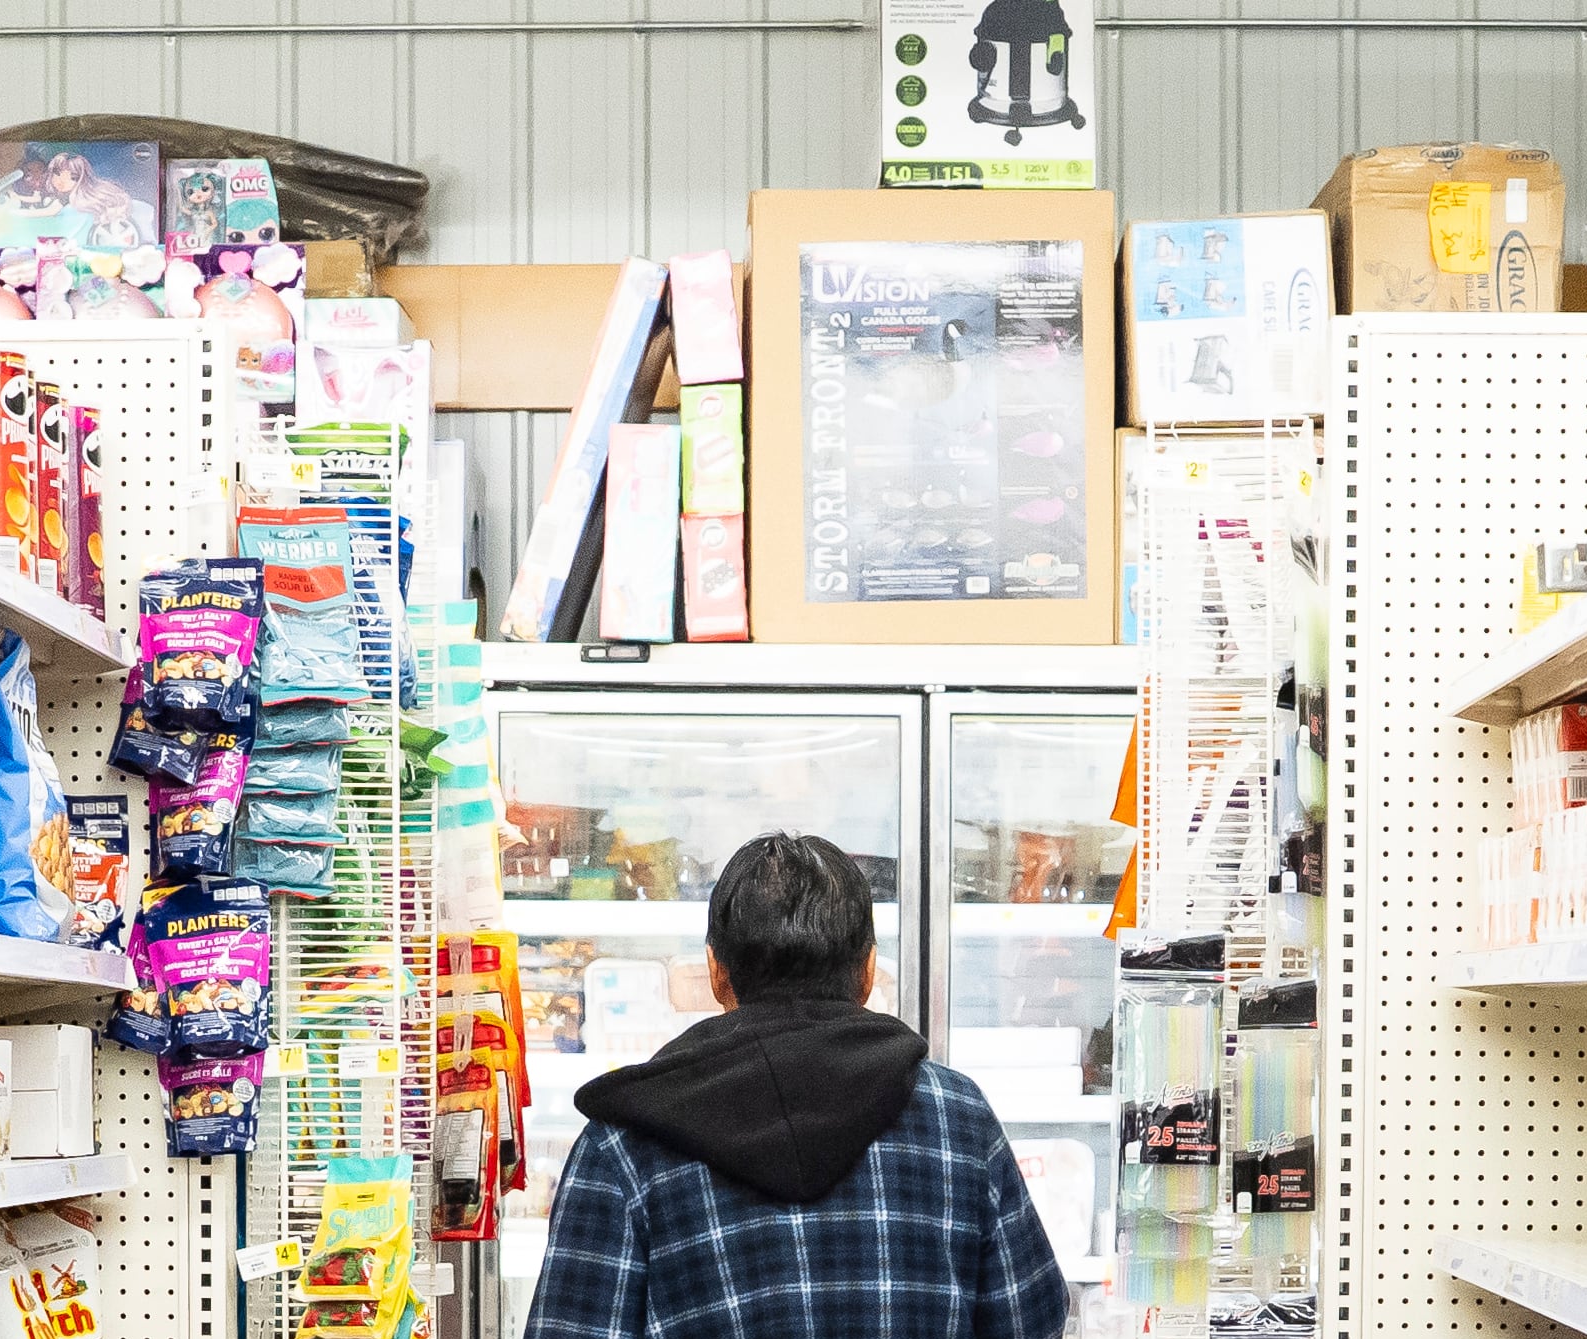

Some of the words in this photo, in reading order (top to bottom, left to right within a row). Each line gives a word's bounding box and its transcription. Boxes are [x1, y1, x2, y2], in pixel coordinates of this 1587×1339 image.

[990, 164, 1011, 176] 5.5
[229, 175, 268, 194] OMG
[1507, 247, 1526, 312] GRAC
[860, 316, 900, 326] CANADA
[811, 325, 847, 452] FRONT
[812, 465, 849, 594] STORM
[255, 540, 339, 561] WERNER
[161, 591, 243, 611] PLANTERS
[167, 914, 250, 937] PLANTERS
[1147, 1126, 1175, 1147] 25
[1257, 1174, 1280, 1195] 25
